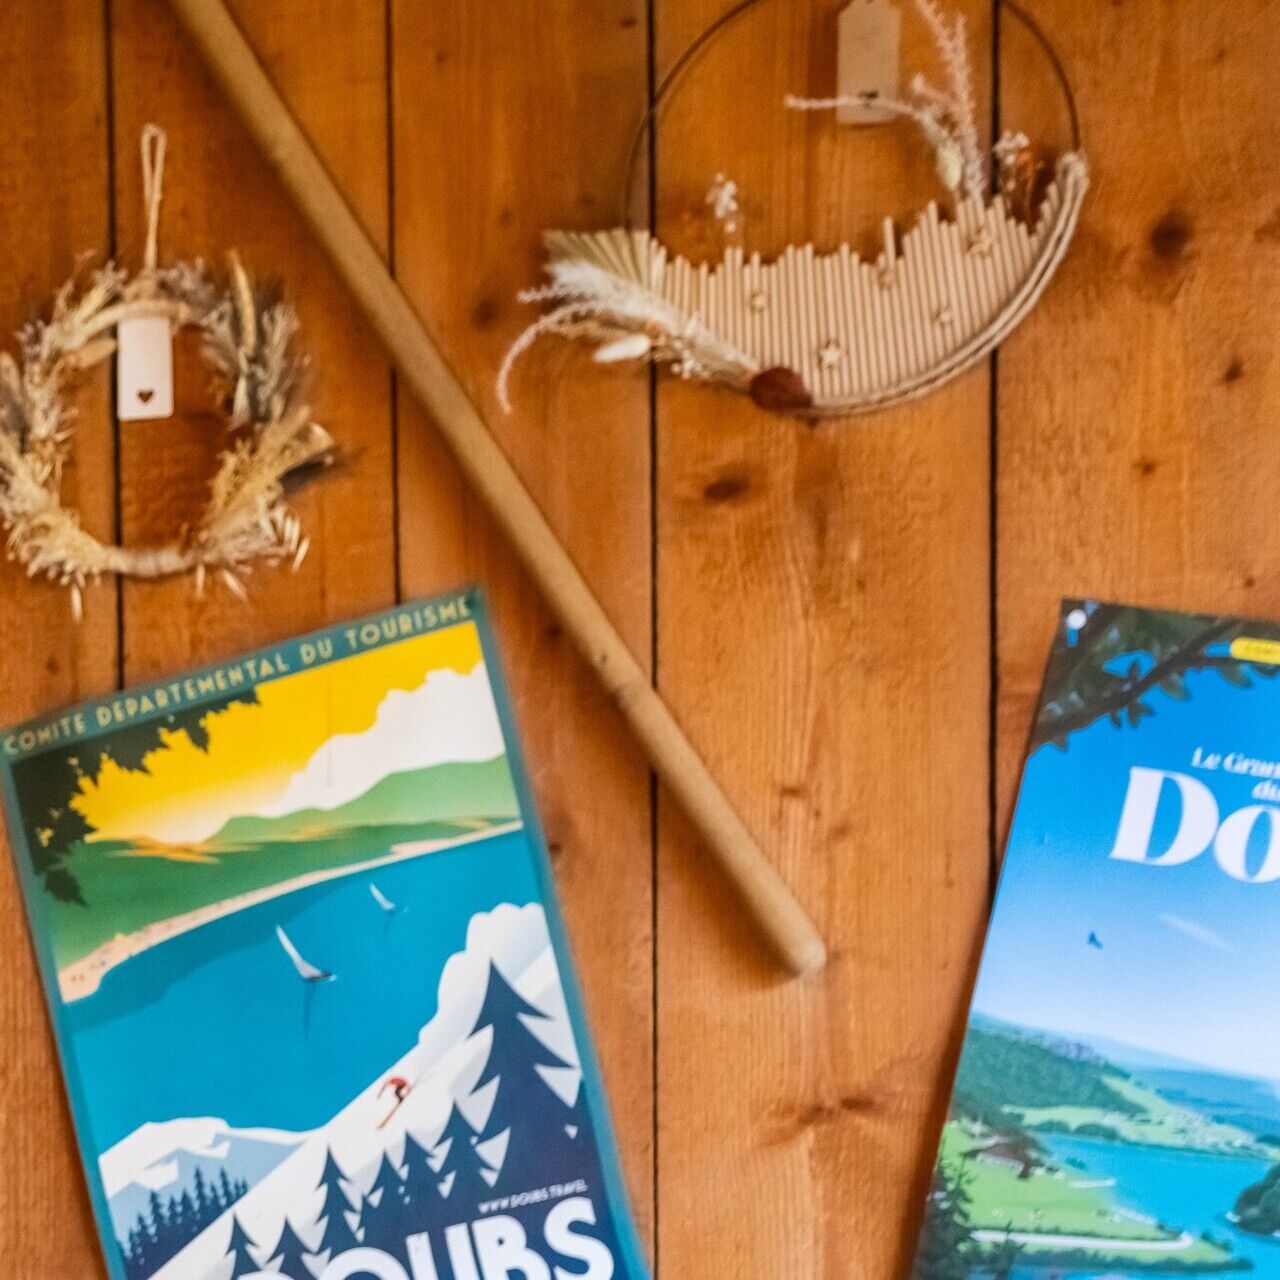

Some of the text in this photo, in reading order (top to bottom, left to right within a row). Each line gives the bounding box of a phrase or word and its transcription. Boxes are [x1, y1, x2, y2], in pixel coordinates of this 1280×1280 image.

[298, 636, 334, 666] DU
[345, 596, 472, 651] TOURISME
[1190, 746, 1222, 771] Le
[1109, 765, 1280, 884] Do
